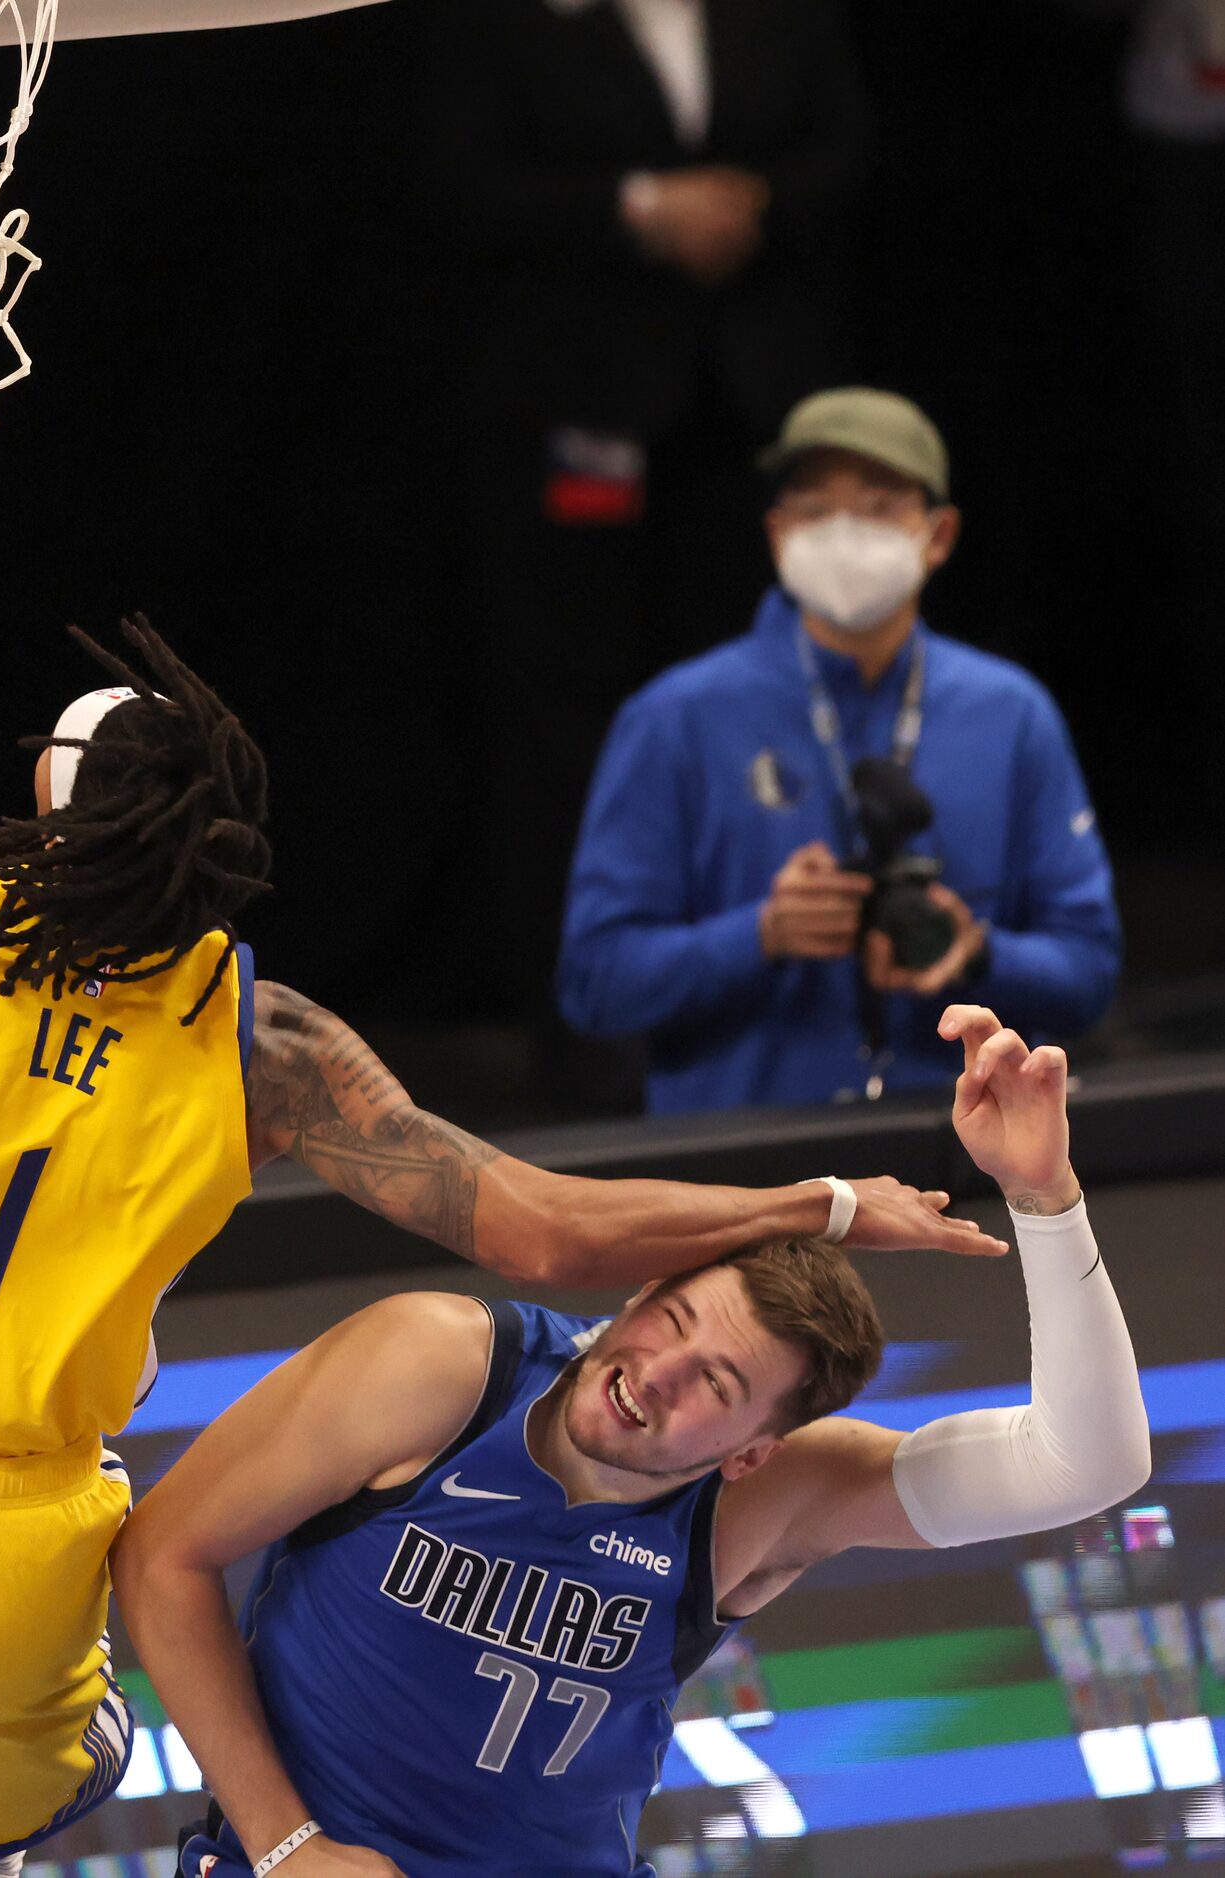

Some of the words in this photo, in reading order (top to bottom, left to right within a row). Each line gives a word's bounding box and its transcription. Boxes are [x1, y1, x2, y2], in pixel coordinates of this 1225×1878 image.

[28, 1007, 124, 1096] LEE
[379, 1522, 653, 1673] DALLAS
[589, 1530, 672, 1575] chime
[474, 1651, 612, 1777] 77
